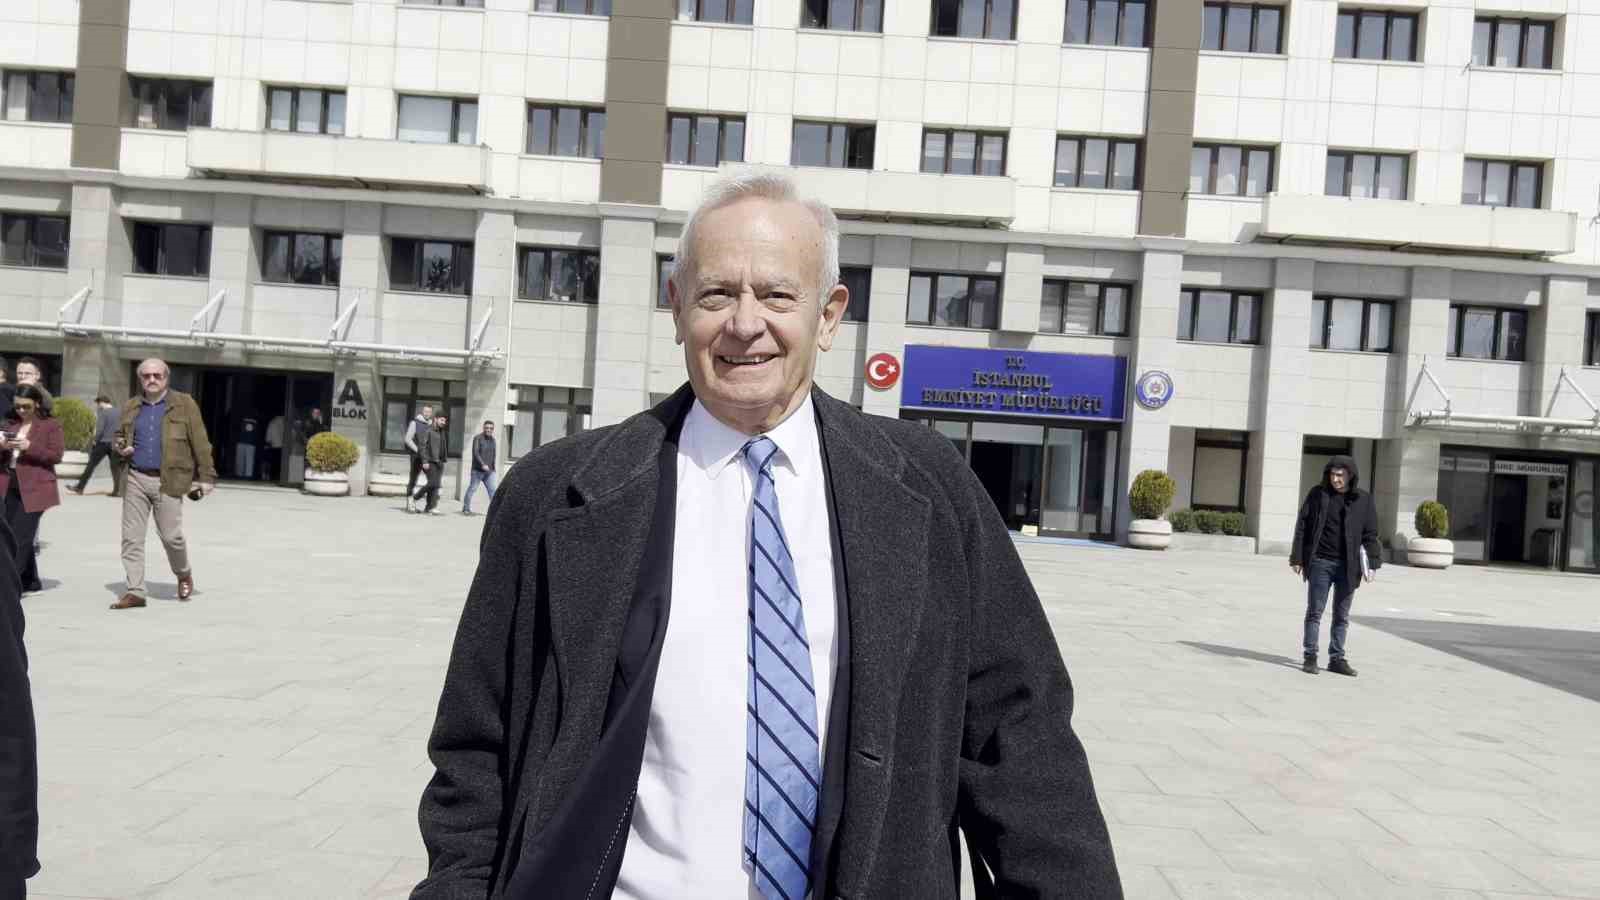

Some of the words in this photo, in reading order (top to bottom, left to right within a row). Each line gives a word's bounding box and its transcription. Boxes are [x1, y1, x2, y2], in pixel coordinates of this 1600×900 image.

[973, 369, 1053, 388] İSTANBUL
[338, 379, 364, 406] A
[922, 387, 998, 405] EMNİYET
[1002, 391, 1104, 412] MÜDÜRLÜĞÜ
[332, 408, 367, 420] BLOK
